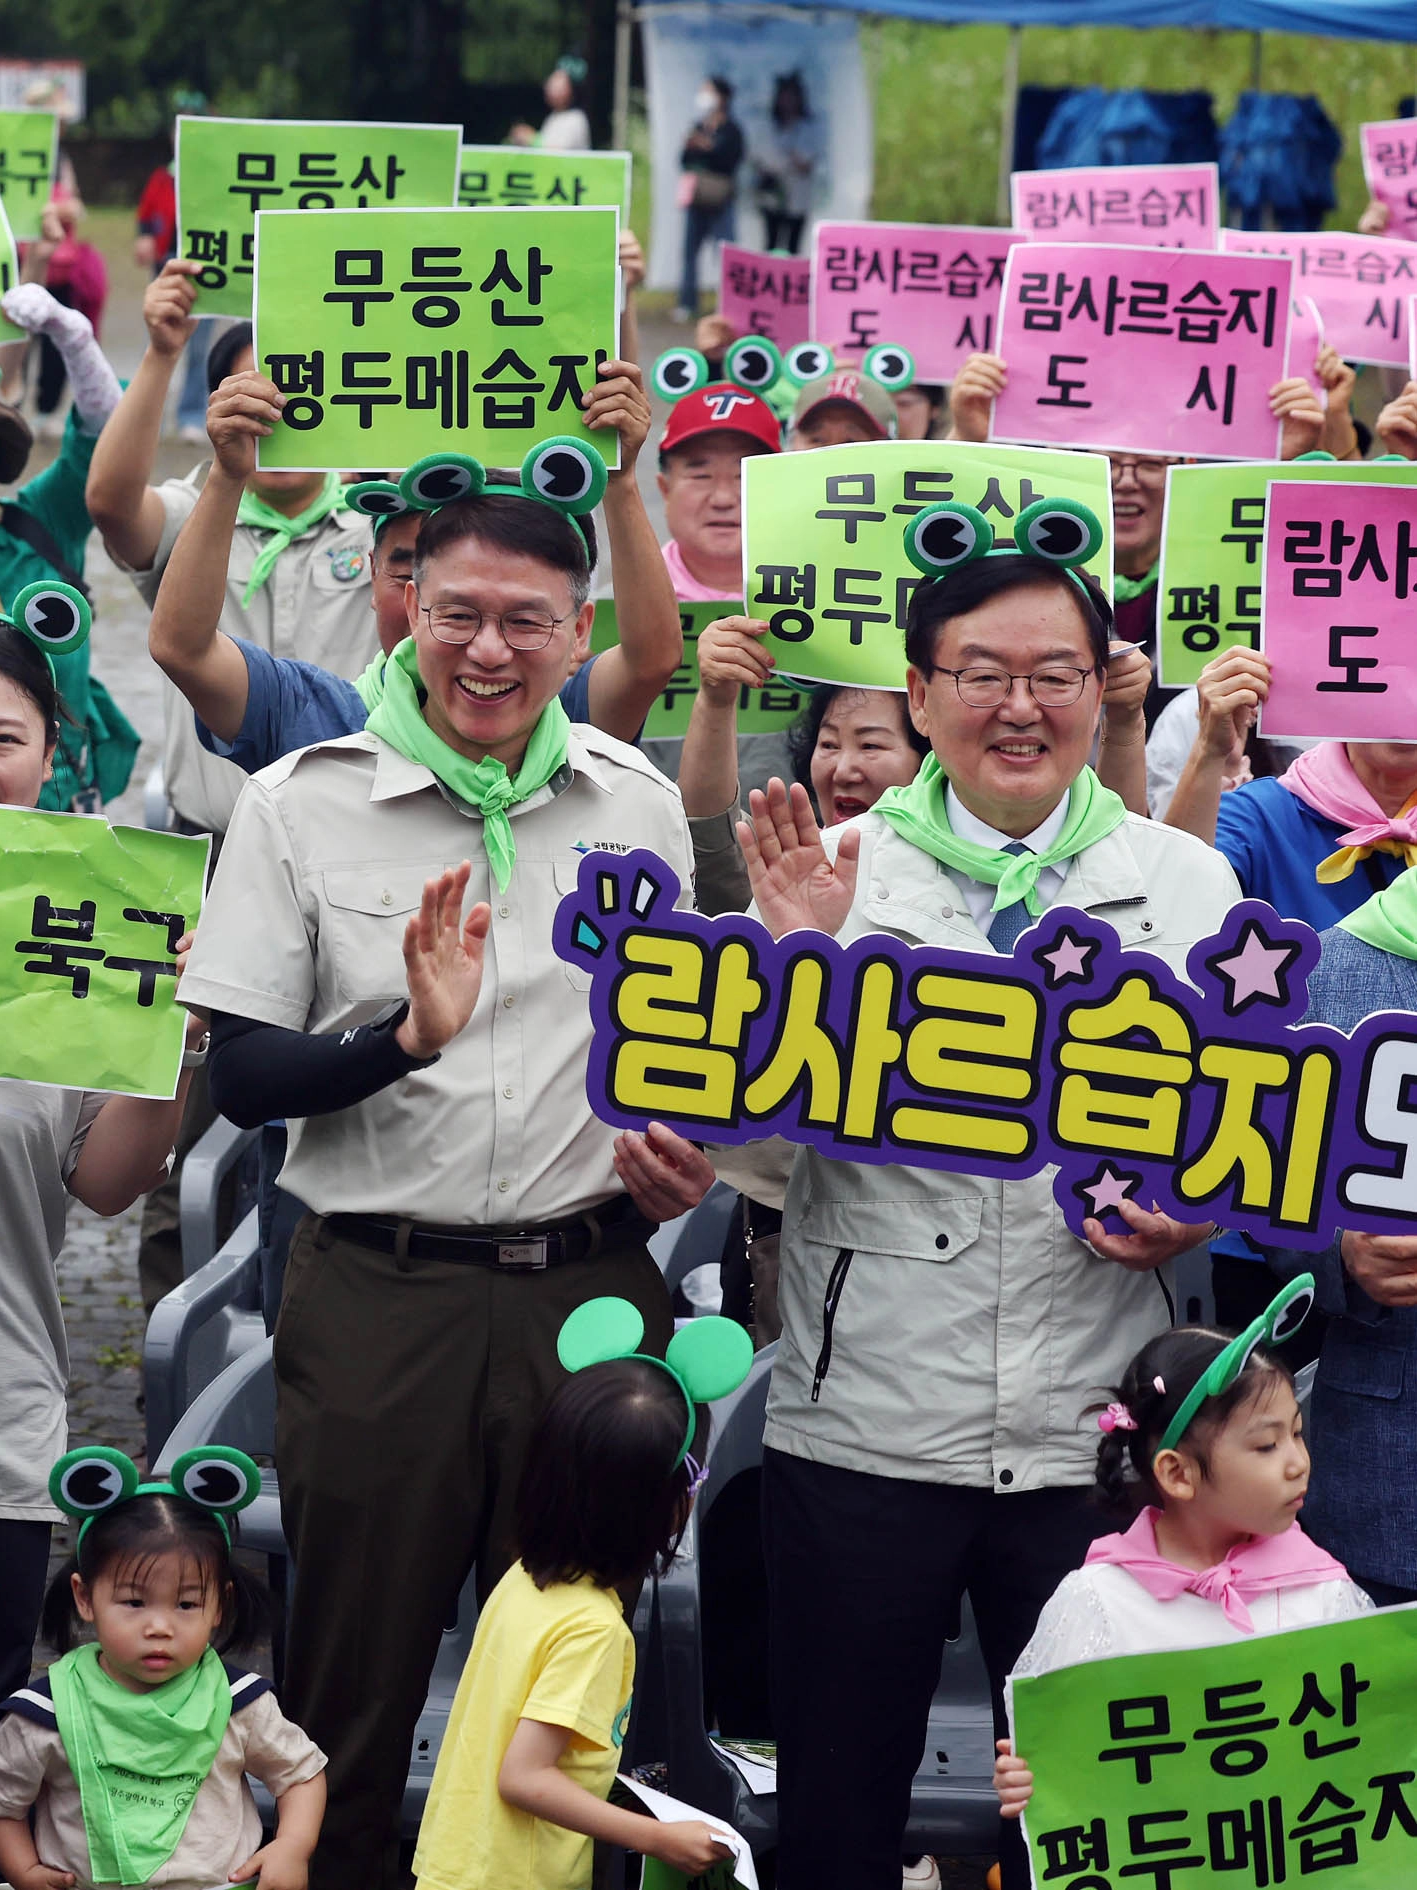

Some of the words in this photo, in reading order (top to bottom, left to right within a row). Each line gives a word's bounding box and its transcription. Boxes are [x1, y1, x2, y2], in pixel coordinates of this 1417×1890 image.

[229, 153, 406, 210] 무등산
[1027, 187, 1207, 229] 람사르습지
[323, 246, 554, 328] 무등산
[1019, 271, 1277, 348] 람사르습지
[1365, 297, 1401, 340] 시
[843, 309, 880, 350] 도
[955, 314, 991, 351] 시
[264, 348, 608, 431] 평두메습지
[1037, 354, 1092, 409] 도
[1185, 363, 1237, 425] 시
[1316, 625, 1388, 693] 도
[14, 894, 186, 1008] 북구
[1098, 1661, 1371, 1785] 무등산
